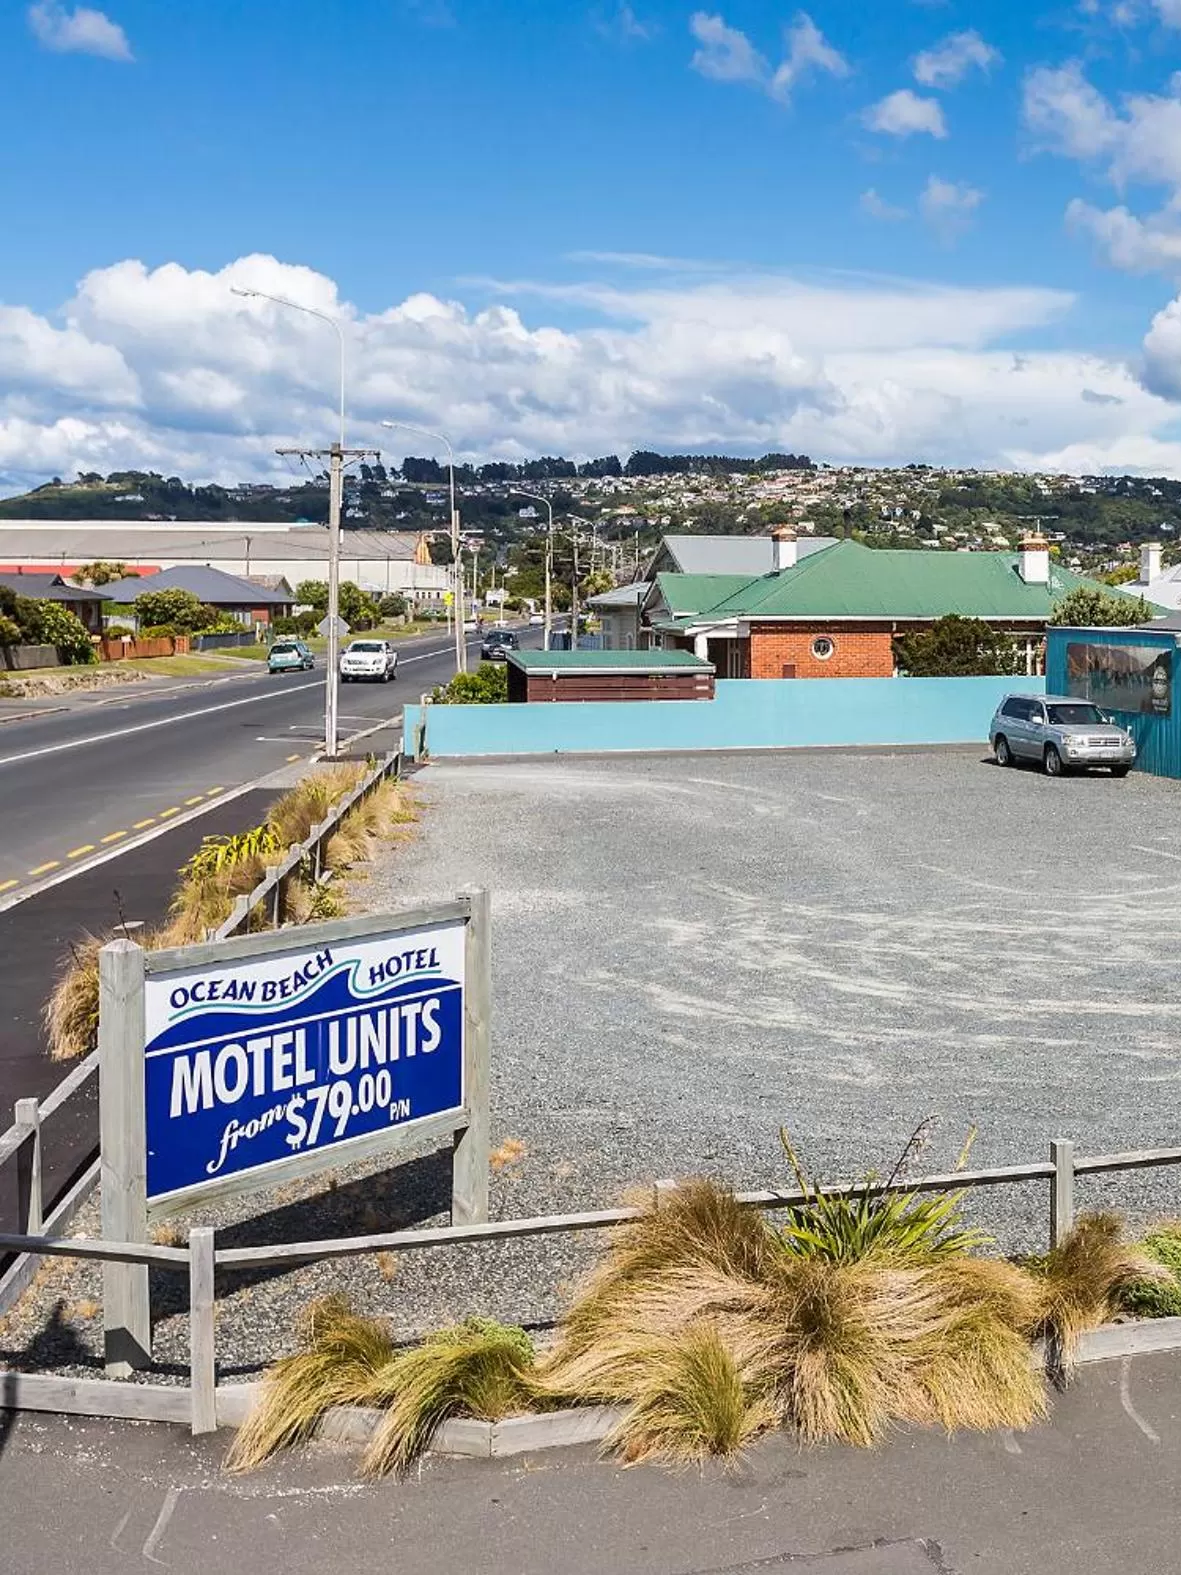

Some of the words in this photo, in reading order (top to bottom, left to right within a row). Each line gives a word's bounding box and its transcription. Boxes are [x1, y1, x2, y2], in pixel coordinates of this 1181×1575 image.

[169, 978, 256, 1009] OCEAN
[261, 948, 334, 1002] BEACH
[369, 947, 441, 986] HOTEL
[169, 1028, 316, 1119] MOTEL
[328, 998, 442, 1075] UNITS
[206, 1104, 287, 1174] from
[286, 1070, 392, 1151] $79.00
[390, 1098, 410, 1121] P/N
